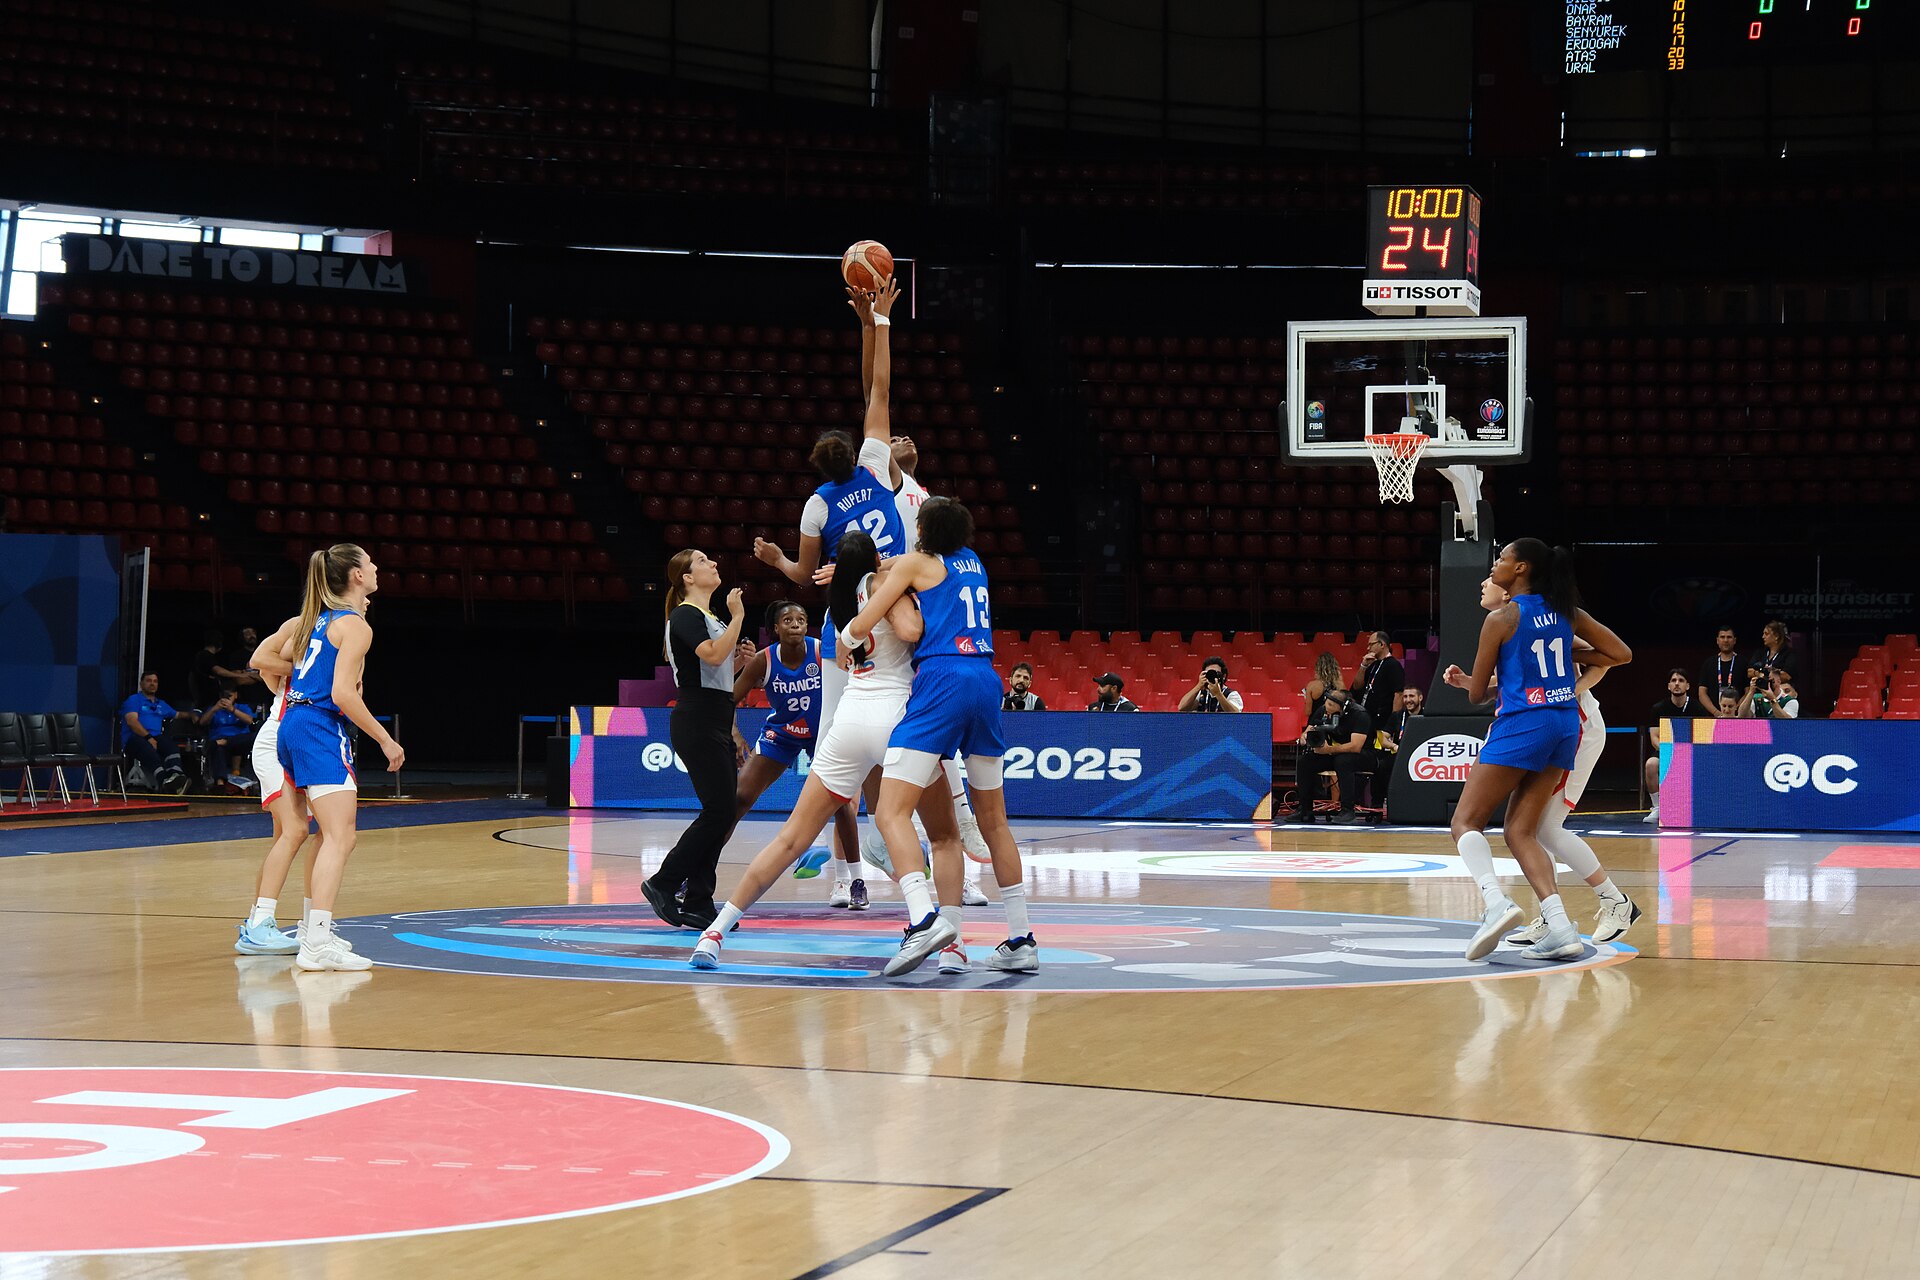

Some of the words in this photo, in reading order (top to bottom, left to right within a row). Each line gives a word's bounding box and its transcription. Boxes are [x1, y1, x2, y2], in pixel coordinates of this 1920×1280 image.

[1566, 3, 1597, 15] ONAR
[1566, 14, 1612, 27] BAYRAM
[1673, 12, 1685, 22] 11
[1848, 18, 1861, 35] 0
[1566, 25, 1627, 39] SENYUREK
[1673, 23, 1685, 34] 15
[1749, 22, 1762, 39] 0
[1565, 37, 1619, 50] ERDOGAN
[1673, 35, 1685, 45] 17
[1565, 50, 1597, 62] ATAS
[1668, 47, 1684, 58] 20
[1565, 62, 1596, 74] URAL
[1668, 59, 1684, 70] 33
[1387, 189, 1463, 218] 10:00
[1382, 227, 1451, 269] 24
[89, 238, 193, 278] DARE
[204, 247, 260, 282] TO
[271, 252, 407, 293] DREAM
[1393, 287, 1462, 299] TISSOT
[1309, 422, 1323, 430] FIBA
[837, 488, 872, 512] RUPERT
[1765, 592, 1914, 605] EUROBASKET
[959, 586, 989, 628] 13
[1533, 612, 1557, 628] AYAYI
[1531, 638, 1565, 678] 11
[772, 676, 821, 694] FRANCE
[1545, 686, 1573, 698] CAISSE
[786, 723, 810, 735] MAIF
[1003, 746, 1142, 781] 2025
[1763, 753, 1858, 795] @C
